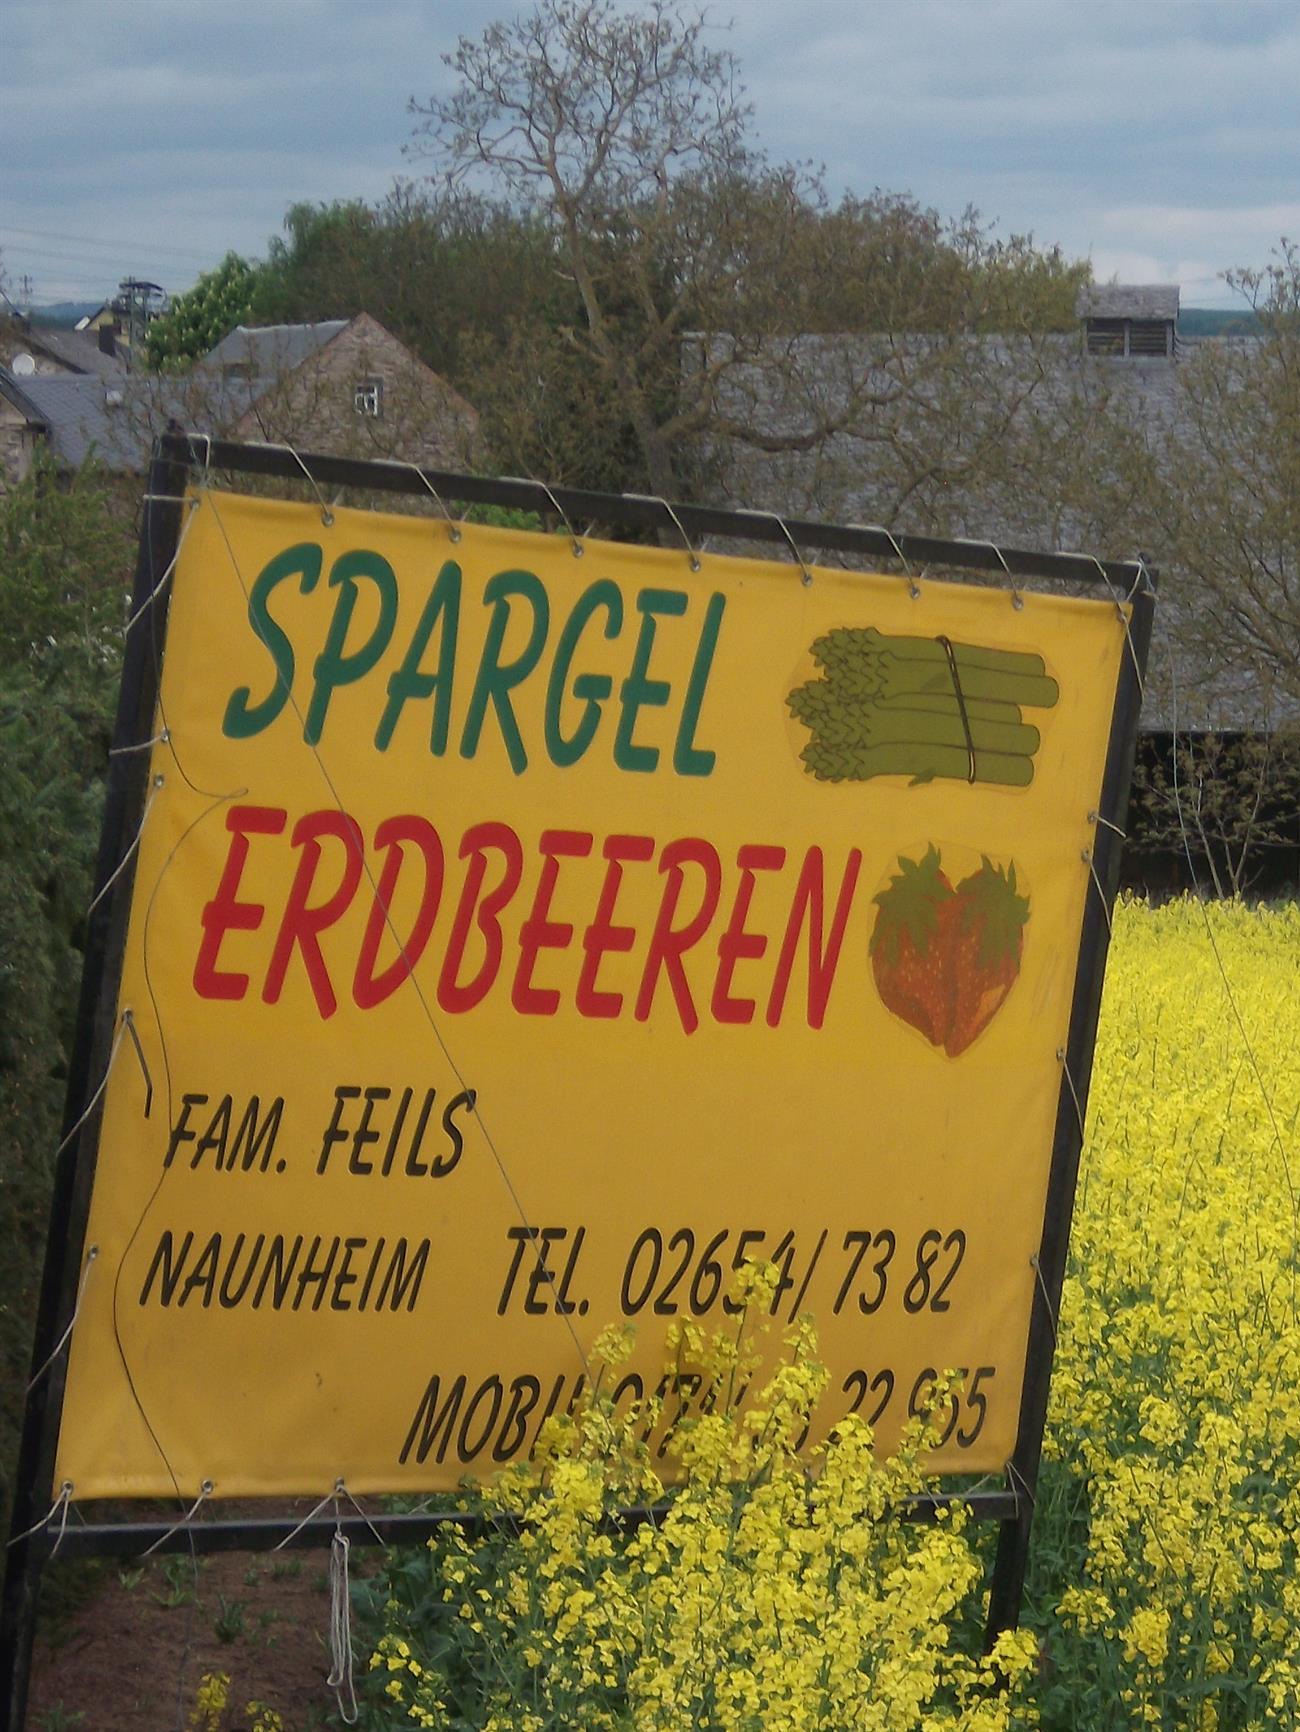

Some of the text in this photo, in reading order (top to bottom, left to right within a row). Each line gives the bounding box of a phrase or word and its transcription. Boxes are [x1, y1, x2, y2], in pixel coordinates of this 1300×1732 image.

[222, 542, 726, 776] SPARGEL
[193, 806, 862, 1036] ERDBEEREN
[163, 1085, 477, 1179] FAM. FEILS
[139, 1229, 431, 1313] NAUNHEIM
[496, 1226, 590, 1316] TEL.
[903, 1228, 966, 1314] 82
